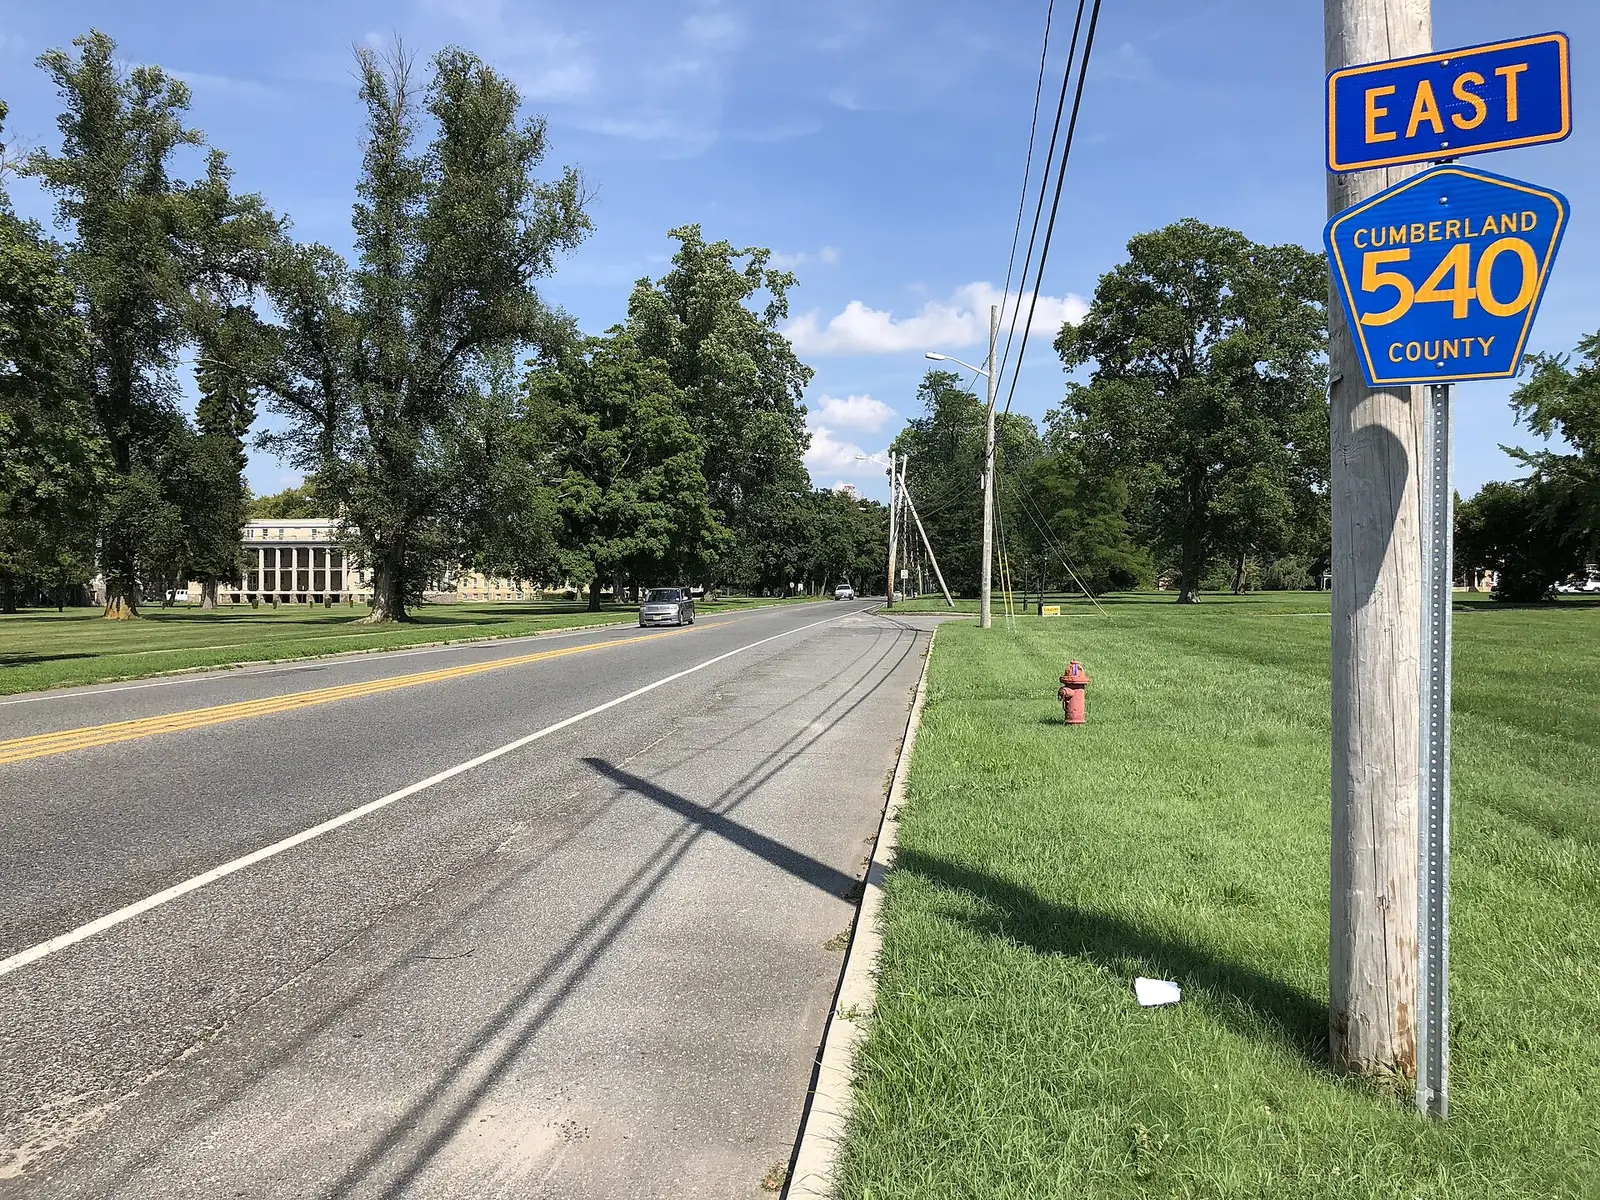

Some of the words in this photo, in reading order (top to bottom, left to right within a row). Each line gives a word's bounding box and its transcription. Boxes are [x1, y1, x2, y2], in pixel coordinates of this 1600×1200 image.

[1365, 63, 1529, 144] EAST
[1353, 210, 1537, 249] CUMBERLAND
[1360, 237, 1538, 326] 540
[1388, 336, 1495, 363] COUNTY
